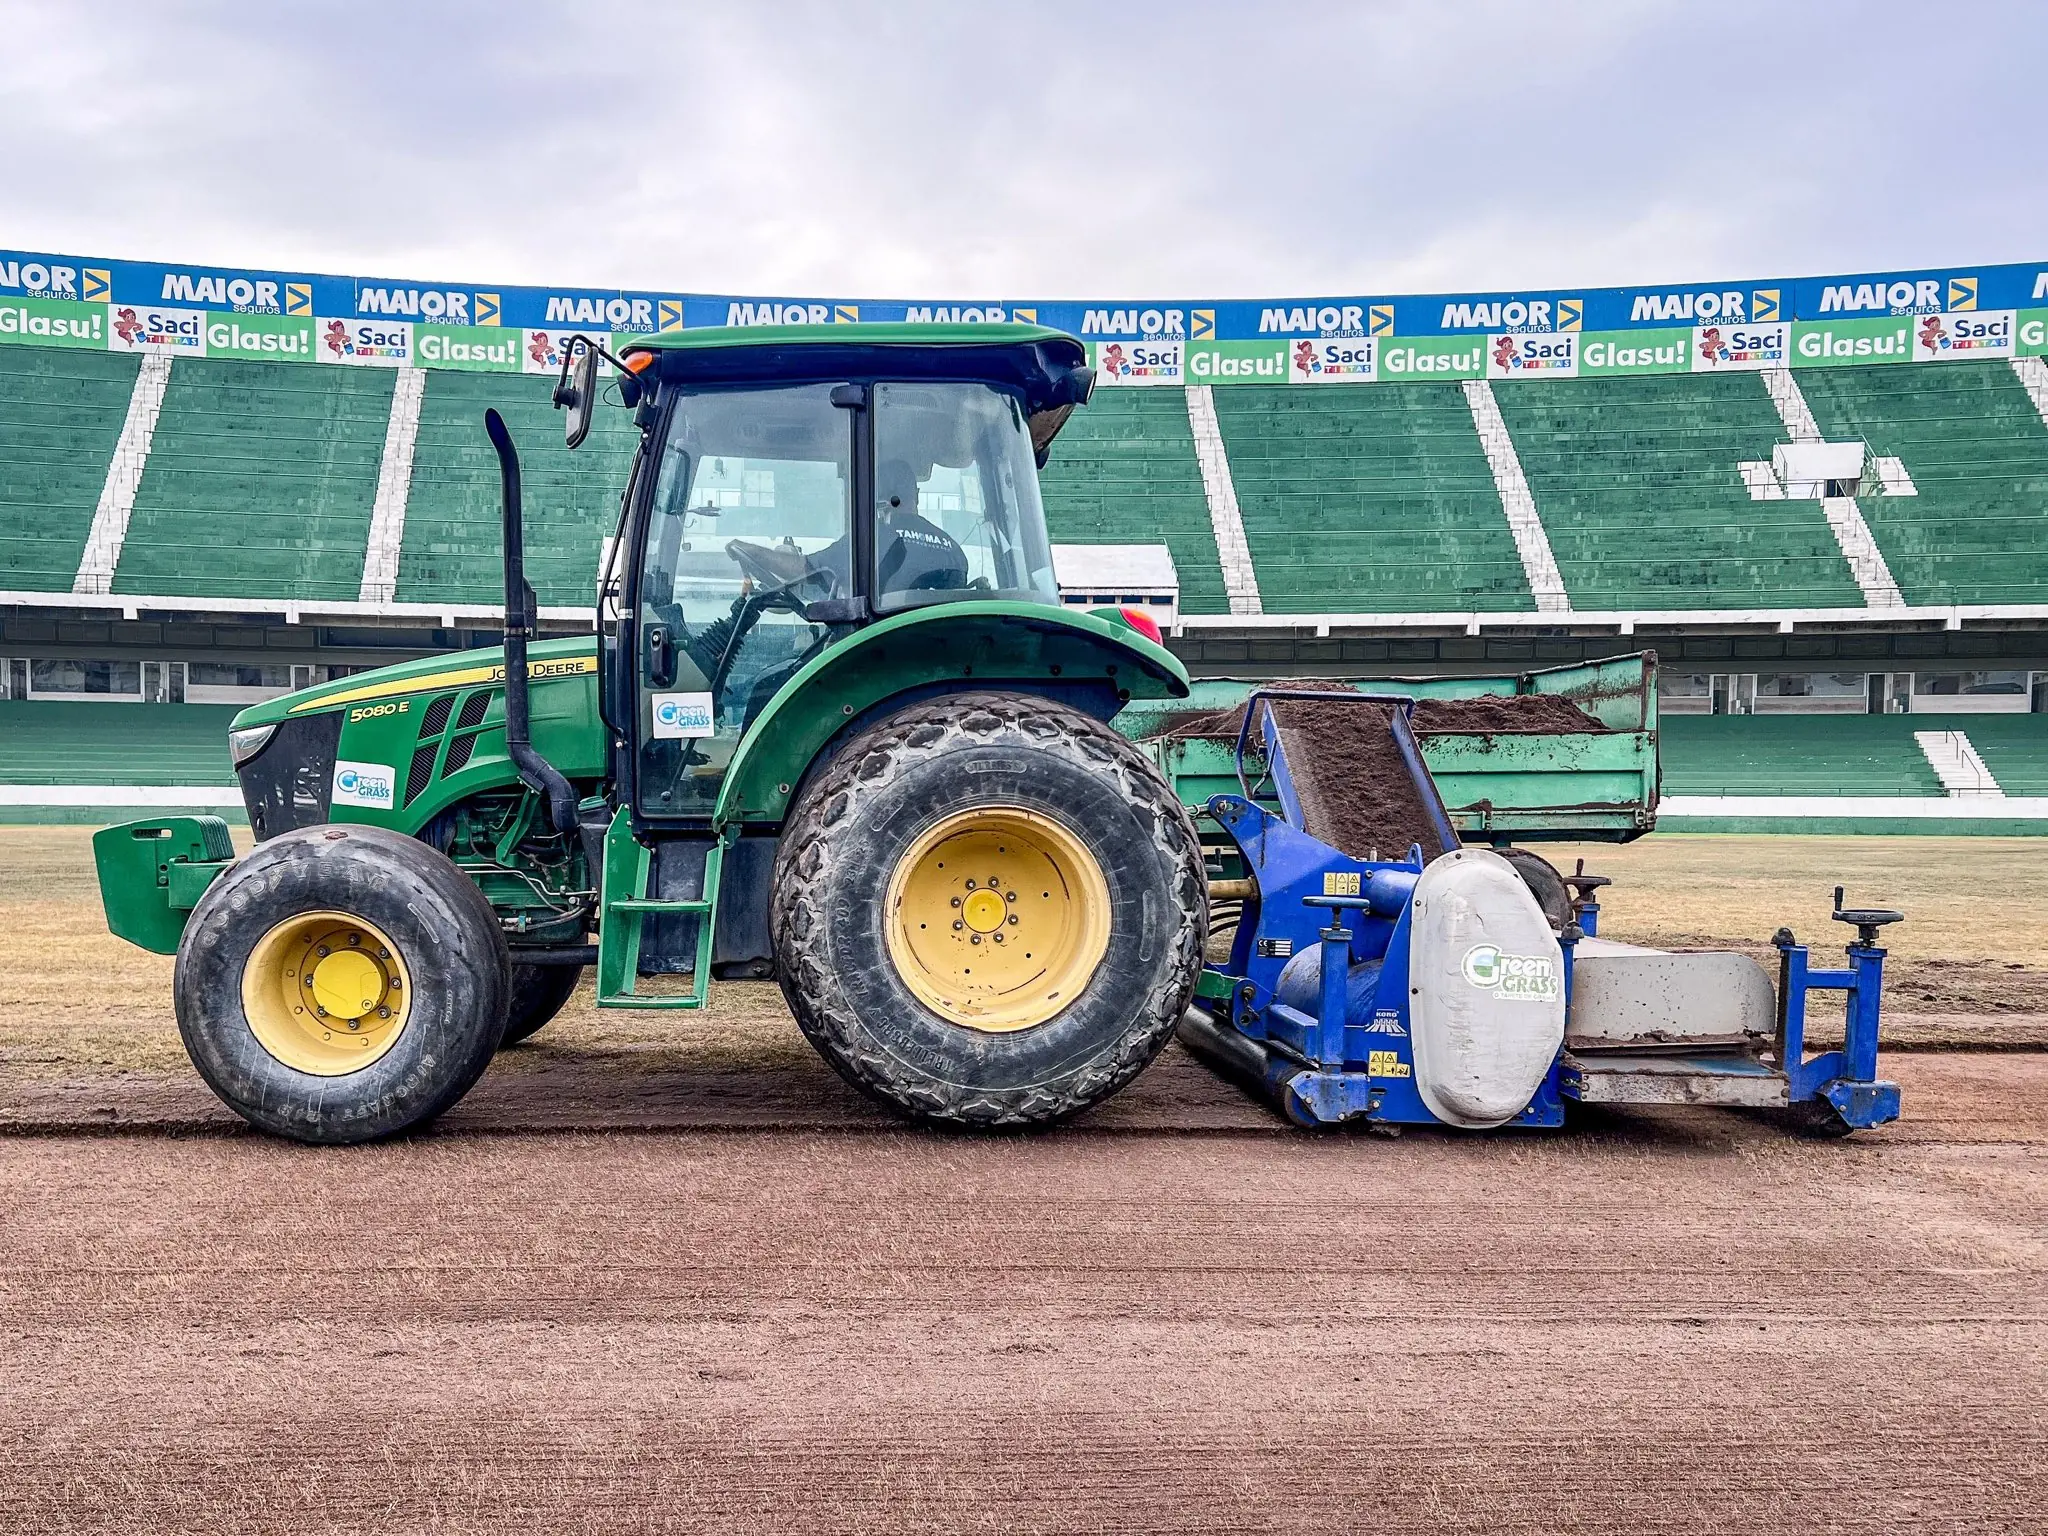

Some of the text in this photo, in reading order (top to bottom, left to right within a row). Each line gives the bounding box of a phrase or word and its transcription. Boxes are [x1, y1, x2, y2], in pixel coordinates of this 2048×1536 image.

[0, 261, 77, 292] IOR
[27, 289, 77, 301] seguros
[162, 274, 280, 307] MAIOR
[1819, 280, 1941, 312] MAIOR
[233, 304, 280, 315] seguros
[359, 288, 469, 317] MAIOR
[546, 297, 653, 324] MAIOR
[1630, 291, 1745, 321] MAIOR
[1890, 304, 1942, 315] seguros
[425, 315, 469, 326] seguros
[727, 302, 828, 325] MAIOR
[905, 306, 1006, 323] MAIOR
[1081, 309, 1185, 334] MAIOR
[1259, 306, 1364, 332] MAIOR
[1441, 301, 1551, 328] MAIOR
[1698, 315, 1746, 326] seguros
[0, 308, 102, 340] Glasu!
[148, 314, 198, 335] Saci
[610, 323, 654, 333] seguros
[1506, 324, 1552, 334] seguros
[1954, 315, 2009, 338] Saci
[148, 335, 198, 346] TINTAS
[207, 323, 309, 354] Glasu!
[358, 327, 406, 346] Saci
[1143, 333, 1185, 341] seguros
[1320, 329, 1364, 339] seguros
[1732, 328, 1783, 350] Saci
[1798, 330, 1907, 357] Glasu!
[1953, 338, 2008, 349] TINTAS
[357, 347, 405, 357] TINTAS
[419, 335, 516, 364] Glasu!
[559, 337, 605, 355] Sai
[1132, 346, 1178, 365] Saci
[1325, 344, 1372, 363] Saci
[1523, 338, 1571, 358] Saci
[1583, 341, 1686, 367] Glasu!
[1190, 352, 1284, 376] Glasu!
[1384, 348, 1481, 373] Glasu!
[1523, 359, 1571, 368] TINTAS
[1730, 351, 1781, 361] TINTAS
[1132, 368, 1177, 376] TINTAS
[1325, 365, 1371, 374] TINTAS
[487, 662, 585, 680] JO DEERE
[351, 701, 410, 722] 5080 E
[657, 701, 705, 724] Green
[679, 716, 710, 726] GRASS
[337, 770, 387, 792] Green
[358, 787, 390, 797] GRASS
[1463, 944, 1551, 987] Green
[1503, 976, 1557, 993] GRASS
